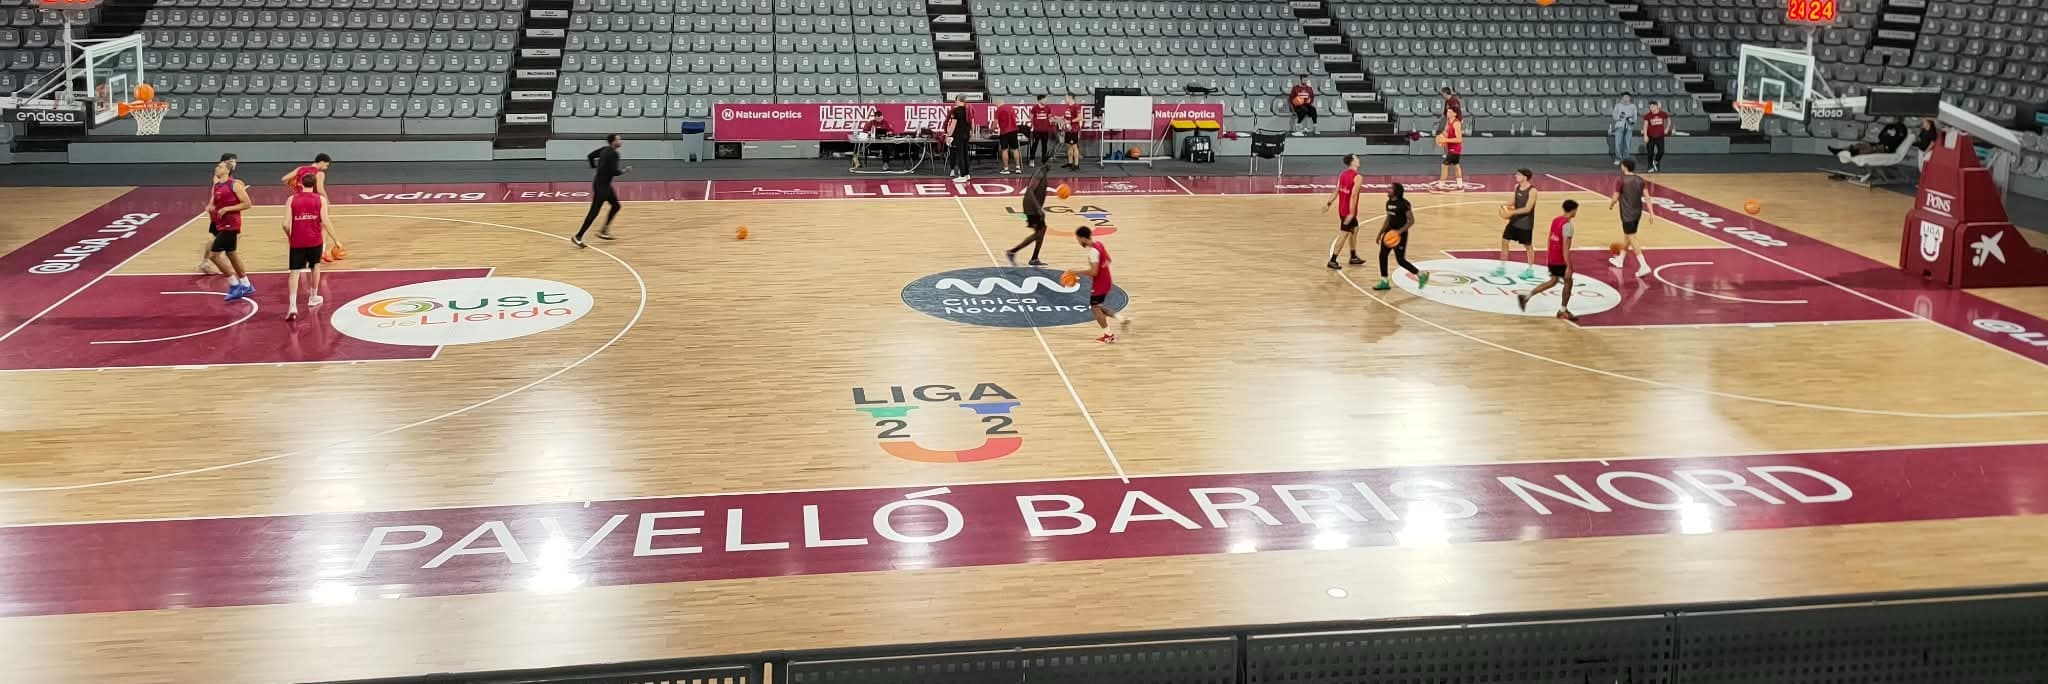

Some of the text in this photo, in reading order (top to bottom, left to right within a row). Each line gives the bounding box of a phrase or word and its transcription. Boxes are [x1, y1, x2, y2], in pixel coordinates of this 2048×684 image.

[1810, 1, 1833, 20] 24
[16, 111, 75, 122] endesa
[735, 110, 770, 119] Natural
[771, 110, 802, 119] Optics
[1155, 110, 1215, 120] Natural Optics
[359, 191, 487, 201] viding
[1926, 192, 1951, 212] PONS
[1005, 205, 1109, 214] LGA
[28, 212, 160, 274] @LIGA_U22
[945, 304, 1091, 315] NovAlianç
[852, 386, 1017, 405] LIGA
[351, 466, 1853, 572] PAVELLÓ BARRIS NORD
